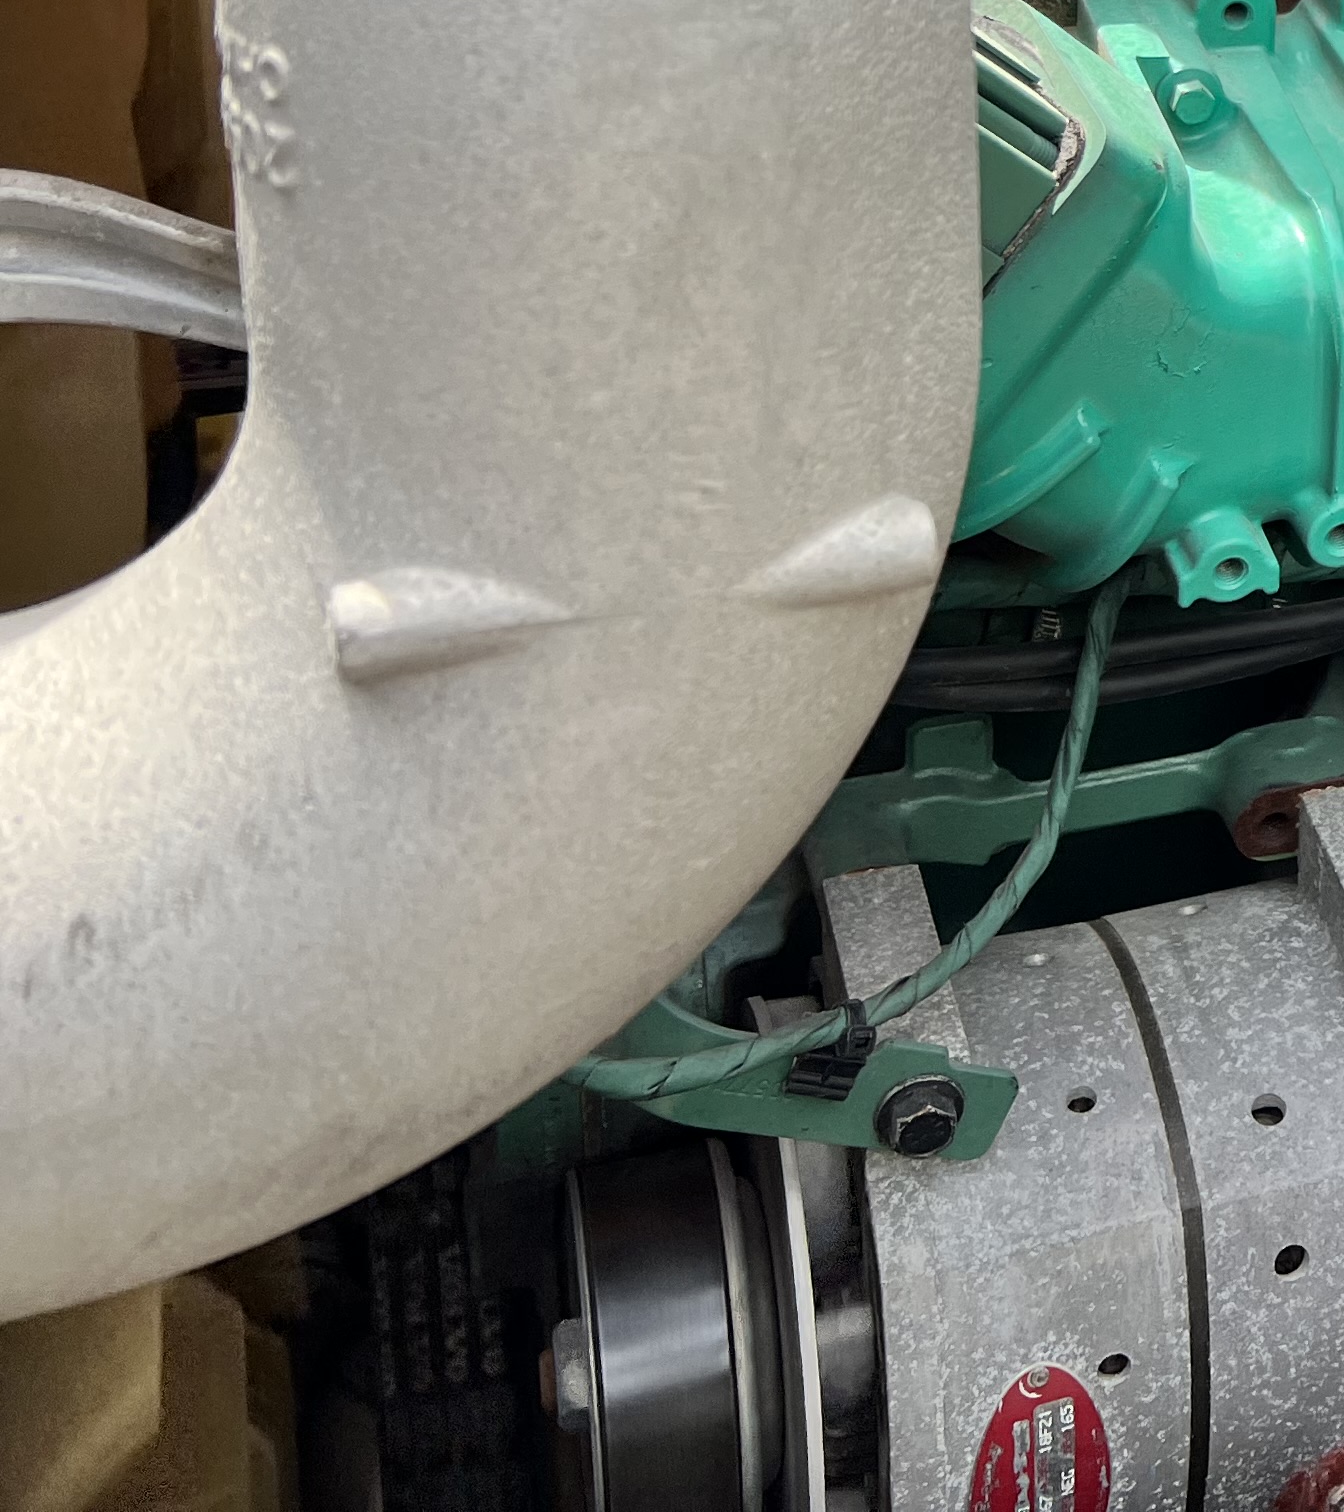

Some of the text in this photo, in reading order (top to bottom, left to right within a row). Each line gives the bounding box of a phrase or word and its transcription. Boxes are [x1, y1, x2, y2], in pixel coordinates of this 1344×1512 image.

[1039, 1404, 1075, 1454] 18F21 165
[1060, 1468, 1075, 1497] NEG
